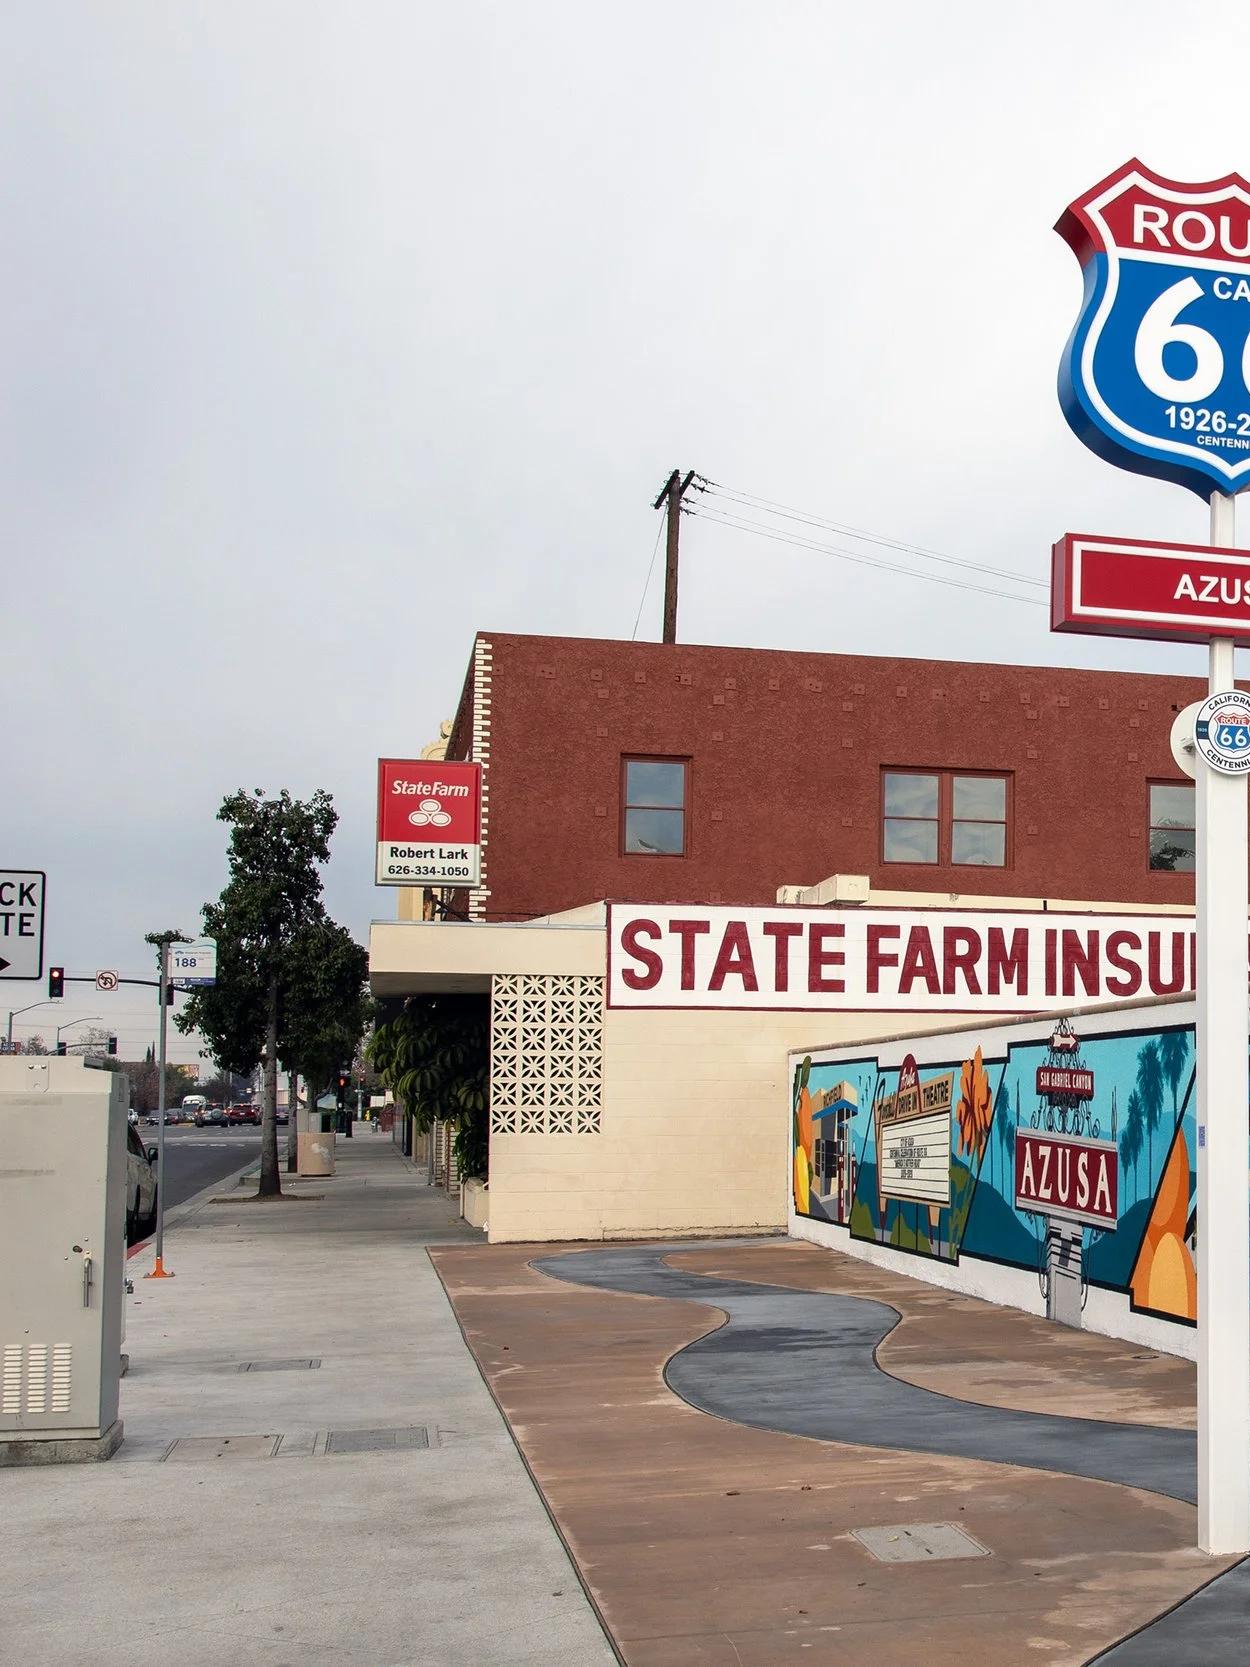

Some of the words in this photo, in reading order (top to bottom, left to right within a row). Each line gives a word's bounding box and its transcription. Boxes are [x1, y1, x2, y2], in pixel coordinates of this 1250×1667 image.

[1220, 717, 1247, 725] ROUTE
[1220, 727, 1247, 747] 66
[390, 846, 435, 859] Robert
[438, 848, 468, 860] Lark
[388, 865, 469, 876] 626-334-1050
[175, 958, 197, 967] 188
[620, 918, 845, 993] STATE
[866, 924, 1029, 996] FARM
[923, 1080, 949, 1108] THEATRE
[1020, 1141, 1112, 1213] AZUSA
